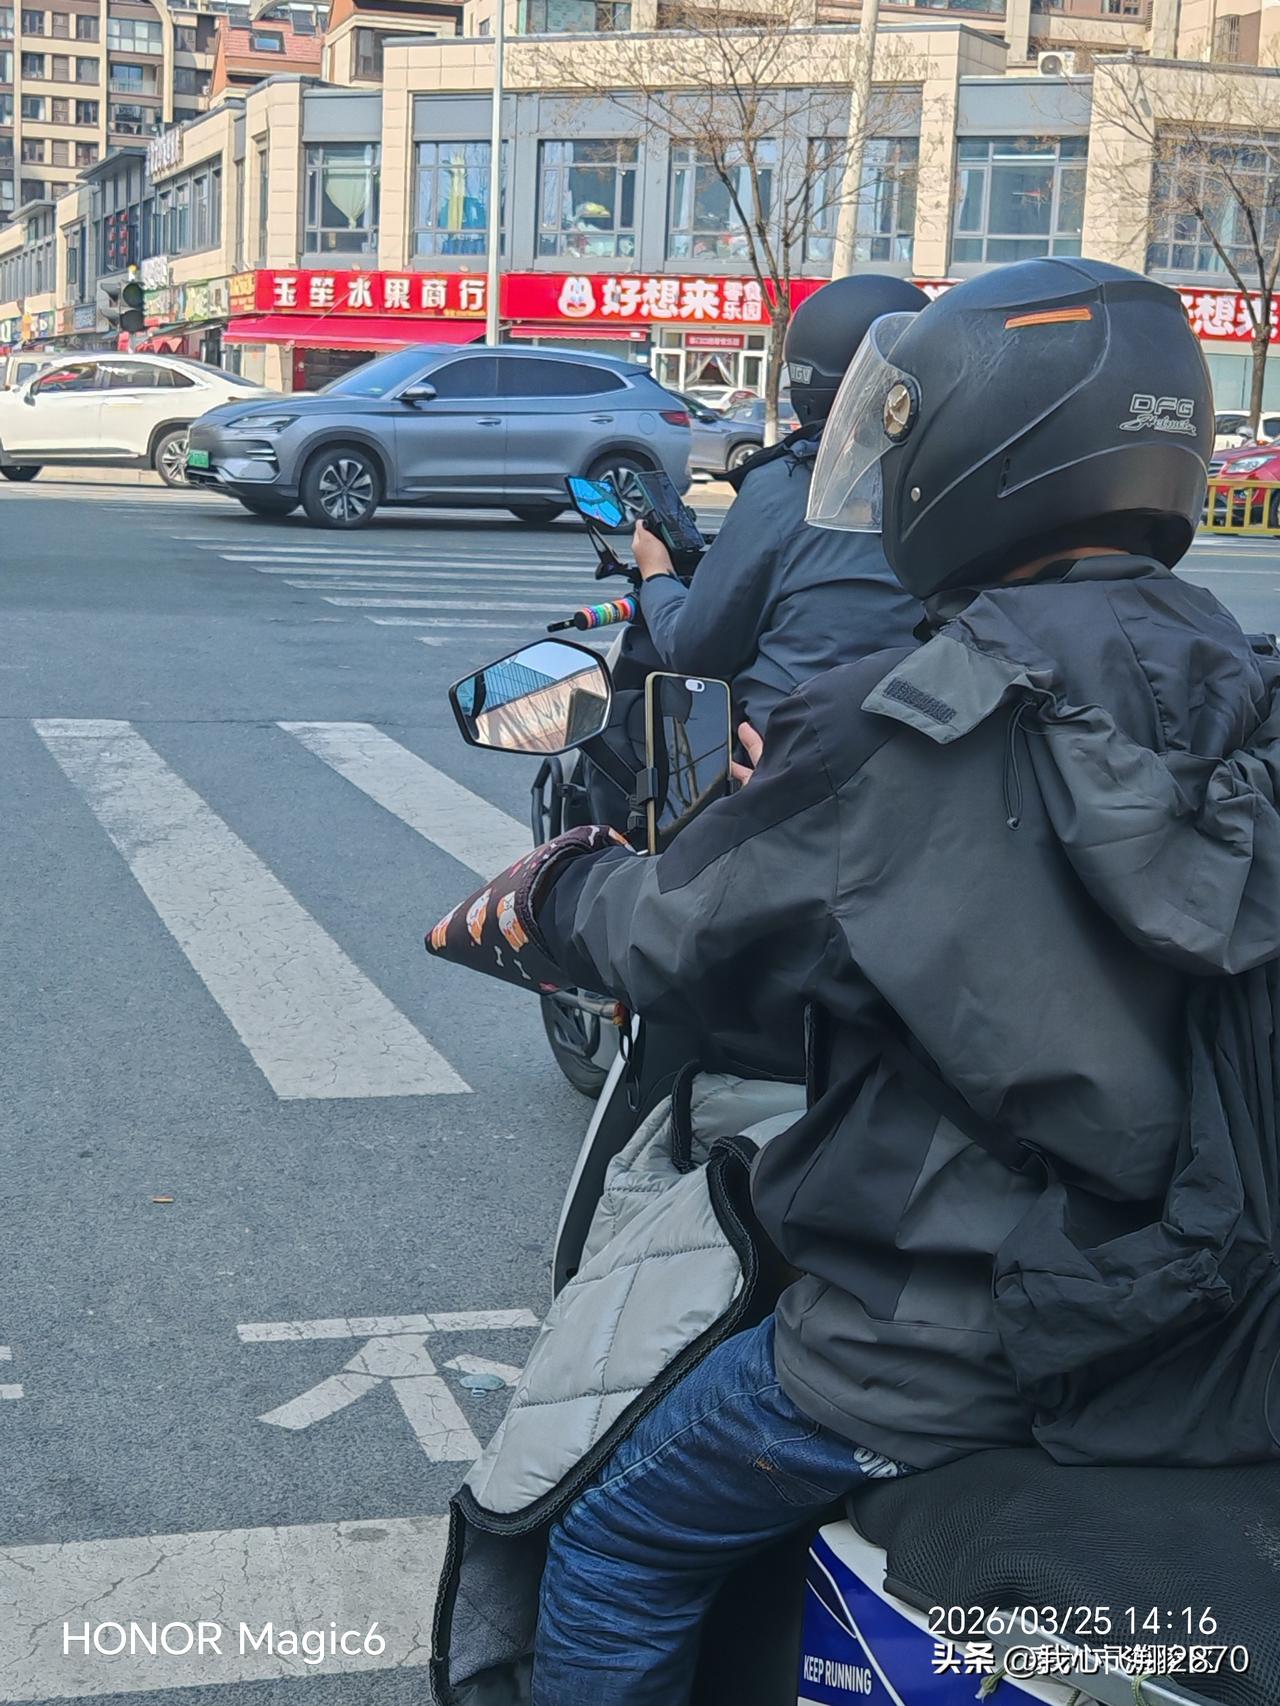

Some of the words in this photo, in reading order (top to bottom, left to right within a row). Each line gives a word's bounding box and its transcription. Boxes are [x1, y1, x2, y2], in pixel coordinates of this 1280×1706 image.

[273, 276, 487, 311] 玉笙水果商行
[602, 278, 719, 319] 好想来
[1129, 393, 1194, 418] DFG
[803, 1654, 825, 1684] KEEP
[825, 1660, 873, 1695] RUNNING
